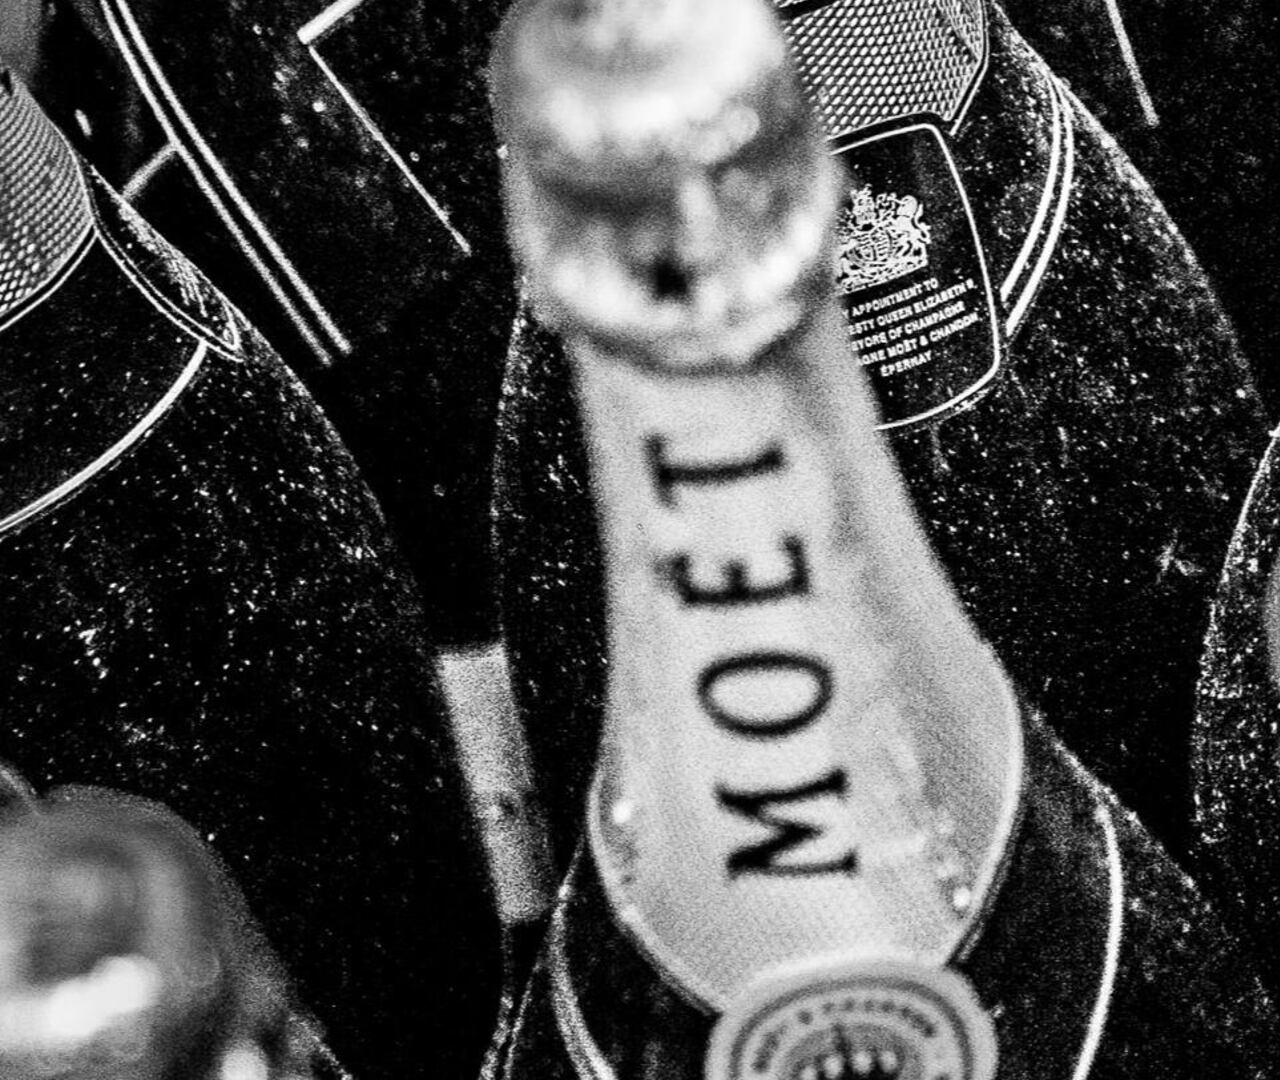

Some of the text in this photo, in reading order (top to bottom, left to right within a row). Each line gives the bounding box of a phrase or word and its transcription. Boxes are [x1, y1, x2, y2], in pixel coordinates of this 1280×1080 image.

[852, 283, 923, 317] APPOINTMENT
[923, 277, 939, 292] TO
[876, 305, 913, 327] QUEEN
[913, 282, 967, 314] ELIZABETH
[888, 326, 903, 341] OF
[904, 300, 966, 334] CHAMPAGNE
[919, 335, 929, 347] &
[929, 311, 979, 342] CHANDON
